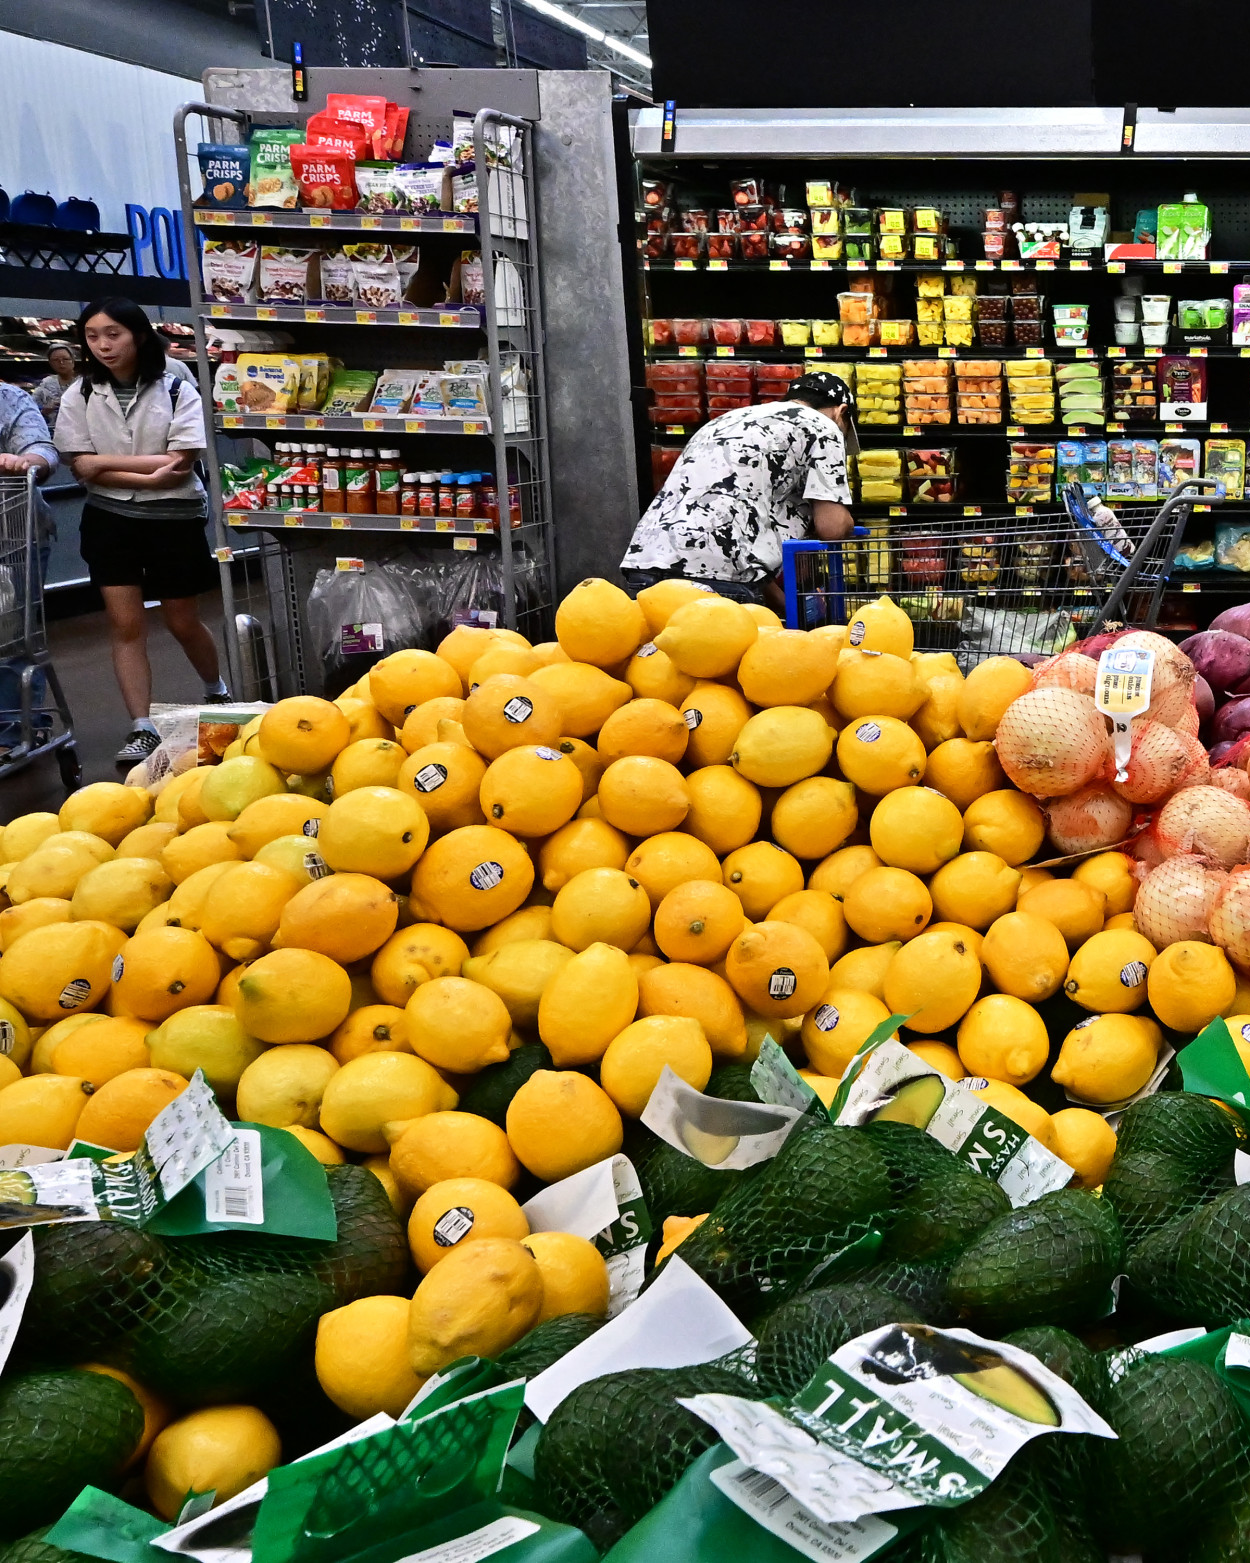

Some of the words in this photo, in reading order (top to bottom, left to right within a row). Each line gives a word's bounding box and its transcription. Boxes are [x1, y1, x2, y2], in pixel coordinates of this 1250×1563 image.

[338, 110, 372, 119] PARM
[318, 137, 353, 148] PARM
[208, 160, 240, 170] PARM
[302, 163, 336, 174] PARM
[205, 169, 243, 181] CRISPS
[301, 173, 341, 185] CRISPS
[1116, 722, 1128, 733] 2
[811, 1378, 968, 1497] SMALL
